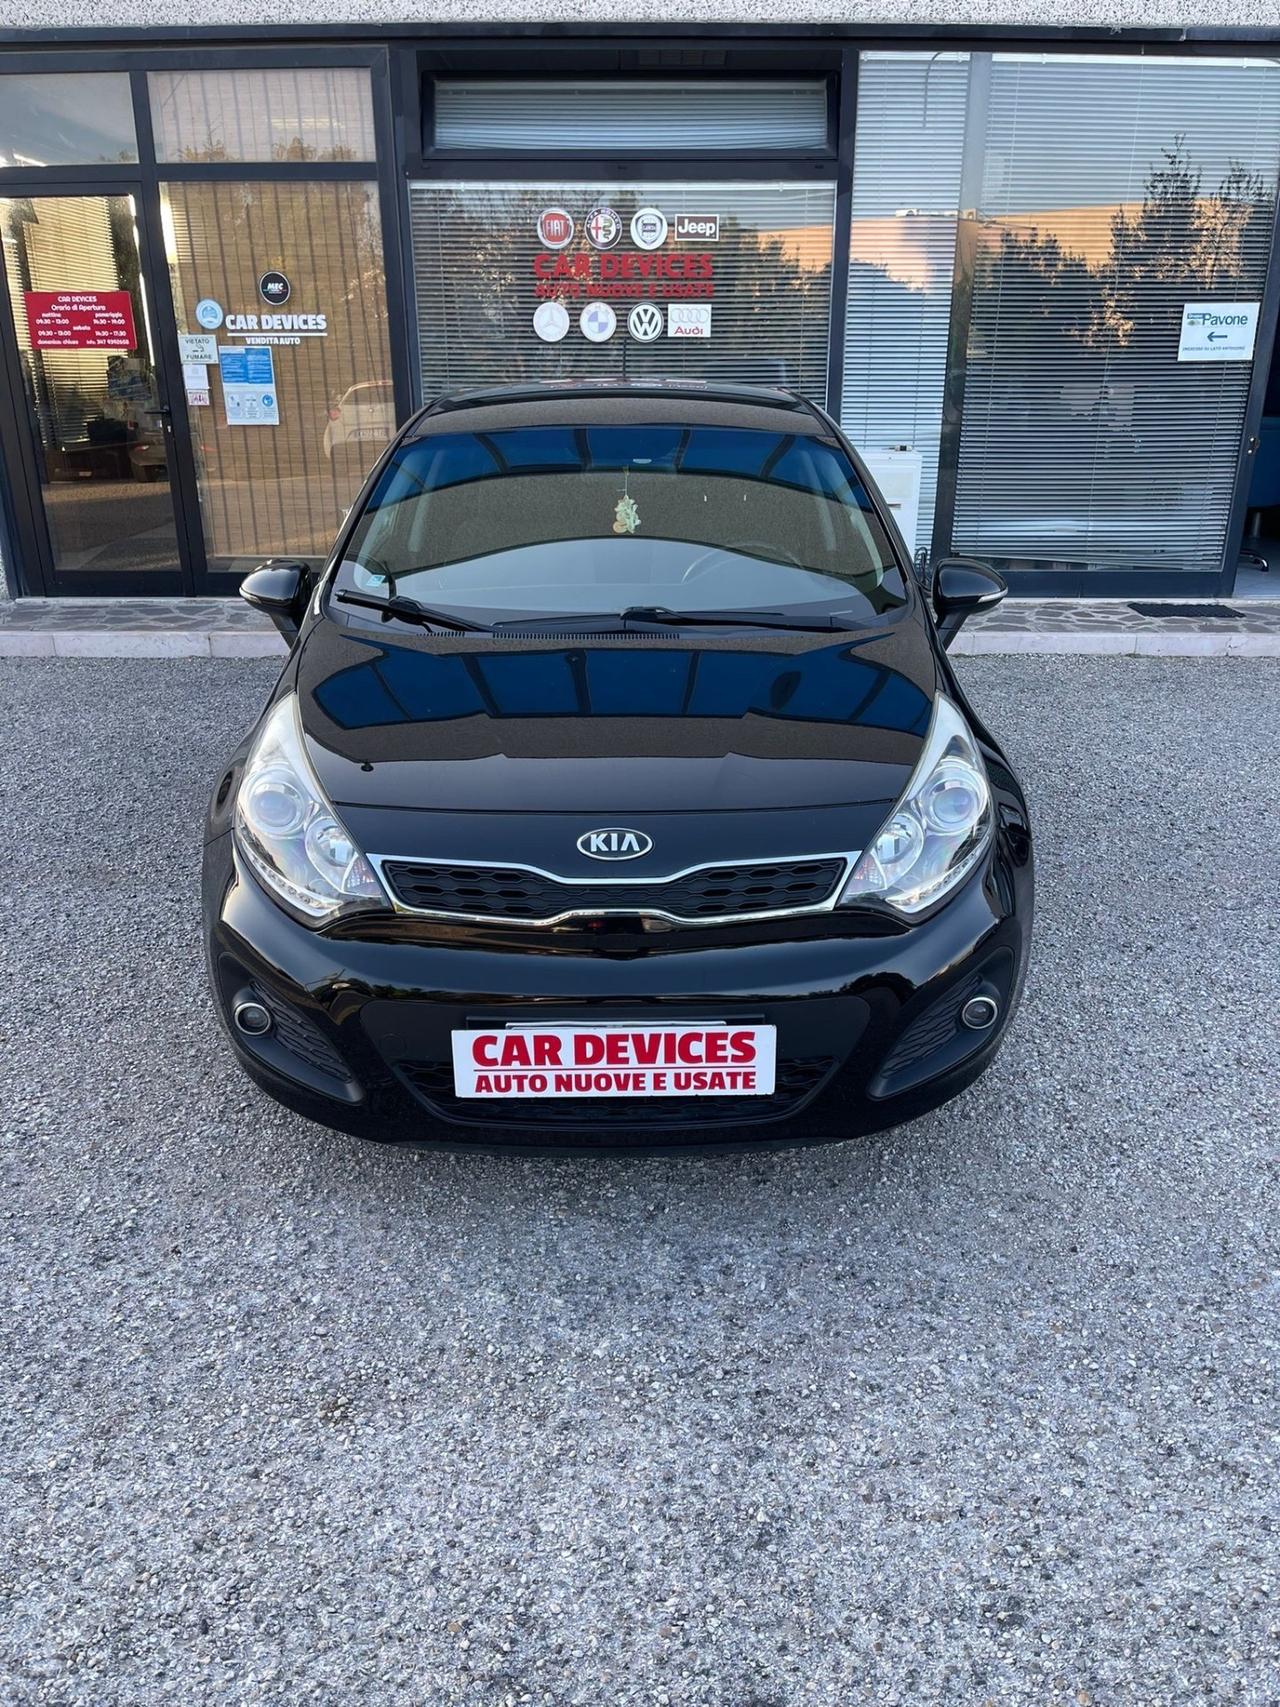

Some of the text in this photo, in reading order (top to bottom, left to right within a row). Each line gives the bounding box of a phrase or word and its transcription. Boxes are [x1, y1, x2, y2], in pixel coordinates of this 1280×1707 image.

[546, 220, 565, 236] FIAT
[678, 218, 716, 238] Jeep
[533, 253, 713, 278] CAR DEVICES
[267, 282, 284, 290] MEC
[78, 304, 106, 312] Apertura
[225, 314, 327, 330] CAR DEVICES
[1202, 313, 1248, 326] Pavone
[674, 326, 704, 335] Audi
[245, 337, 301, 345] VENDITA AUTO
[590, 833, 641, 852] KIA
[472, 1031, 757, 1067] CAR DEVICES
[475, 1071, 757, 1093] AUTO NUOVE E USATE
